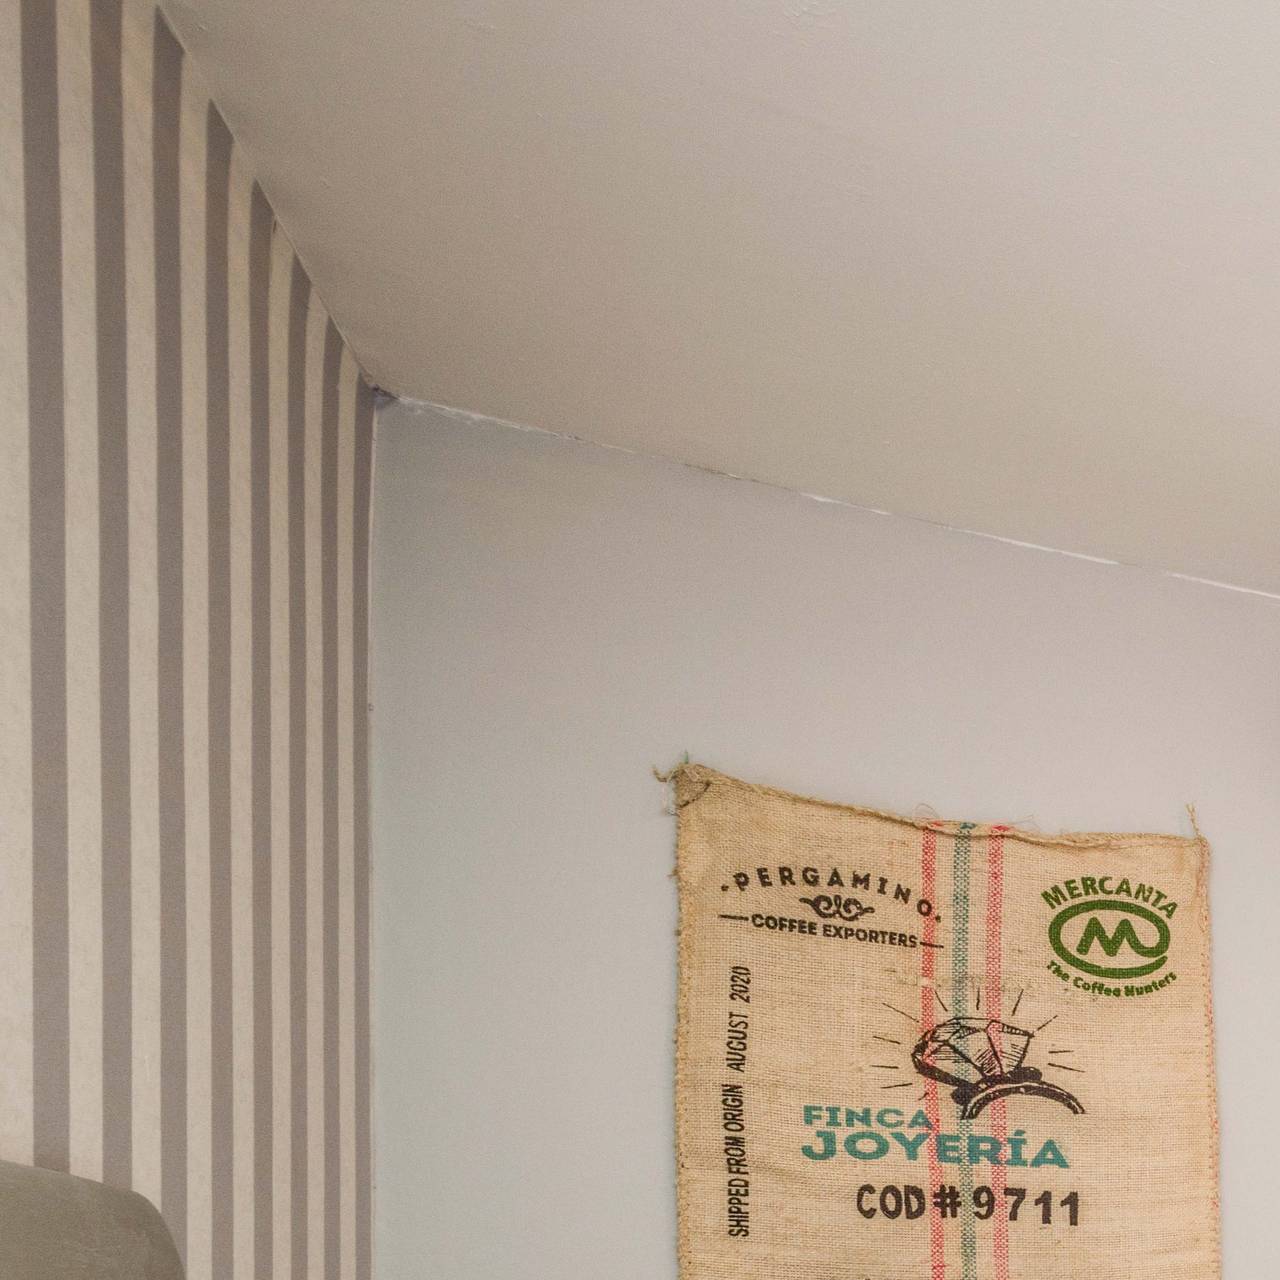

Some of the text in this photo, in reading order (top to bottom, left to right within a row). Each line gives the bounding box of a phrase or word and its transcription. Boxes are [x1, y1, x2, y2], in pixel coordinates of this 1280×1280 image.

[733, 866, 933, 917] PERGAMINO
[1041, 876, 1178, 919] MERCANTA
[751, 913, 918, 949] COFFEE EXPORTERS
[1047, 960, 1177, 997] The Coffee Hunters
[721, 965, 751, 1238] SHIPPED FROM ORIGIN AUGUST 2020
[803, 1105, 933, 1129] FINCA
[801, 1130, 1070, 1169] JOYERÍA
